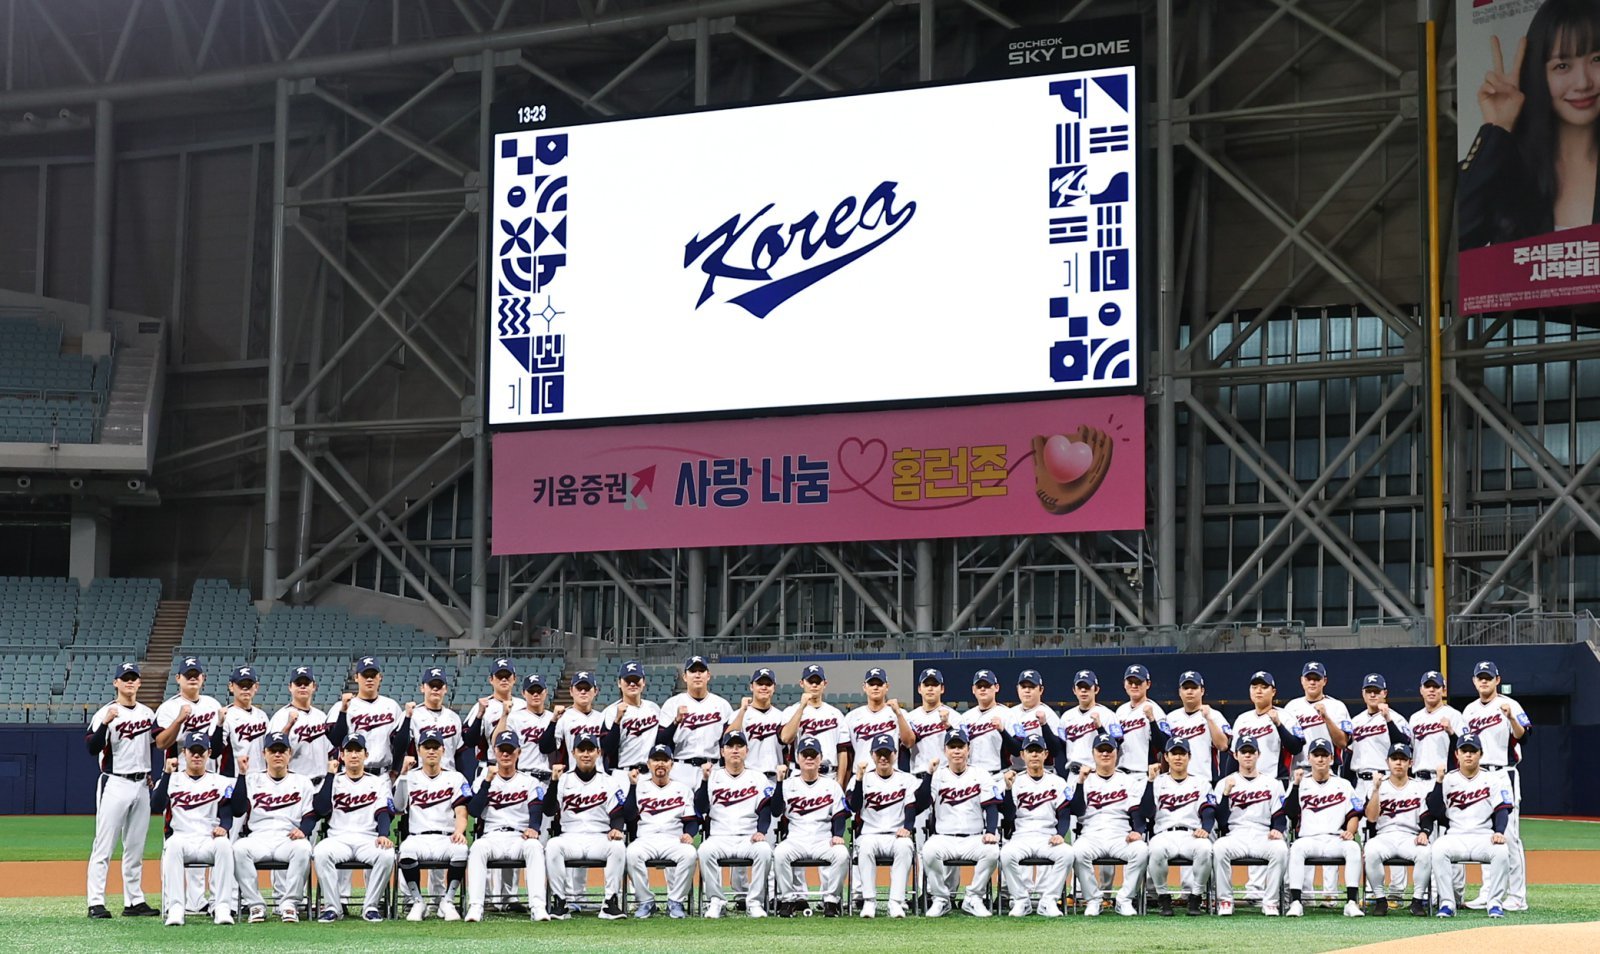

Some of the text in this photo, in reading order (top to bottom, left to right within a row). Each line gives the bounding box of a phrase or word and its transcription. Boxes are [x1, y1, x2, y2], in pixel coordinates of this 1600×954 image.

[1008, 39, 1130, 65] SKY DOME
[1009, 37, 1063, 50] GOCHEOK
[518, 104, 546, 123] 13:23
[683, 180, 917, 319] Korea
[1513, 240, 1600, 265] 주식투자는
[1529, 257, 1600, 282] 시작부터
[673, 444, 1009, 508] 사랑 나눔 홈런존
[532, 472, 628, 507] 키움증권
[351, 713, 394, 732] Korea
[623, 715, 659, 736] Korea
[680, 712, 722, 730] Korea
[800, 718, 838, 736] Korea
[854, 720, 896, 740] Korea
[170, 788, 220, 810] Korea
[253, 792, 301, 811] Korea
[333, 791, 377, 813] Korea
[410, 788, 454, 809] Korea
[488, 790, 528, 810] Korea
[563, 791, 608, 814] Korea
[639, 796, 685, 815] Korea
[712, 786, 758, 807] Korea
[788, 794, 833, 816] Korea
[864, 788, 906, 811] Korea
[939, 784, 981, 806] Korea
[1017, 788, 1057, 811] Korea
[1087, 789, 1128, 809] Korea
[1159, 791, 1200, 812] Korea
[1229, 790, 1272, 809] Korea
[1301, 792, 1346, 812] Korea
[1447, 787, 1490, 810] Korea
[1380, 797, 1420, 818] Korea
